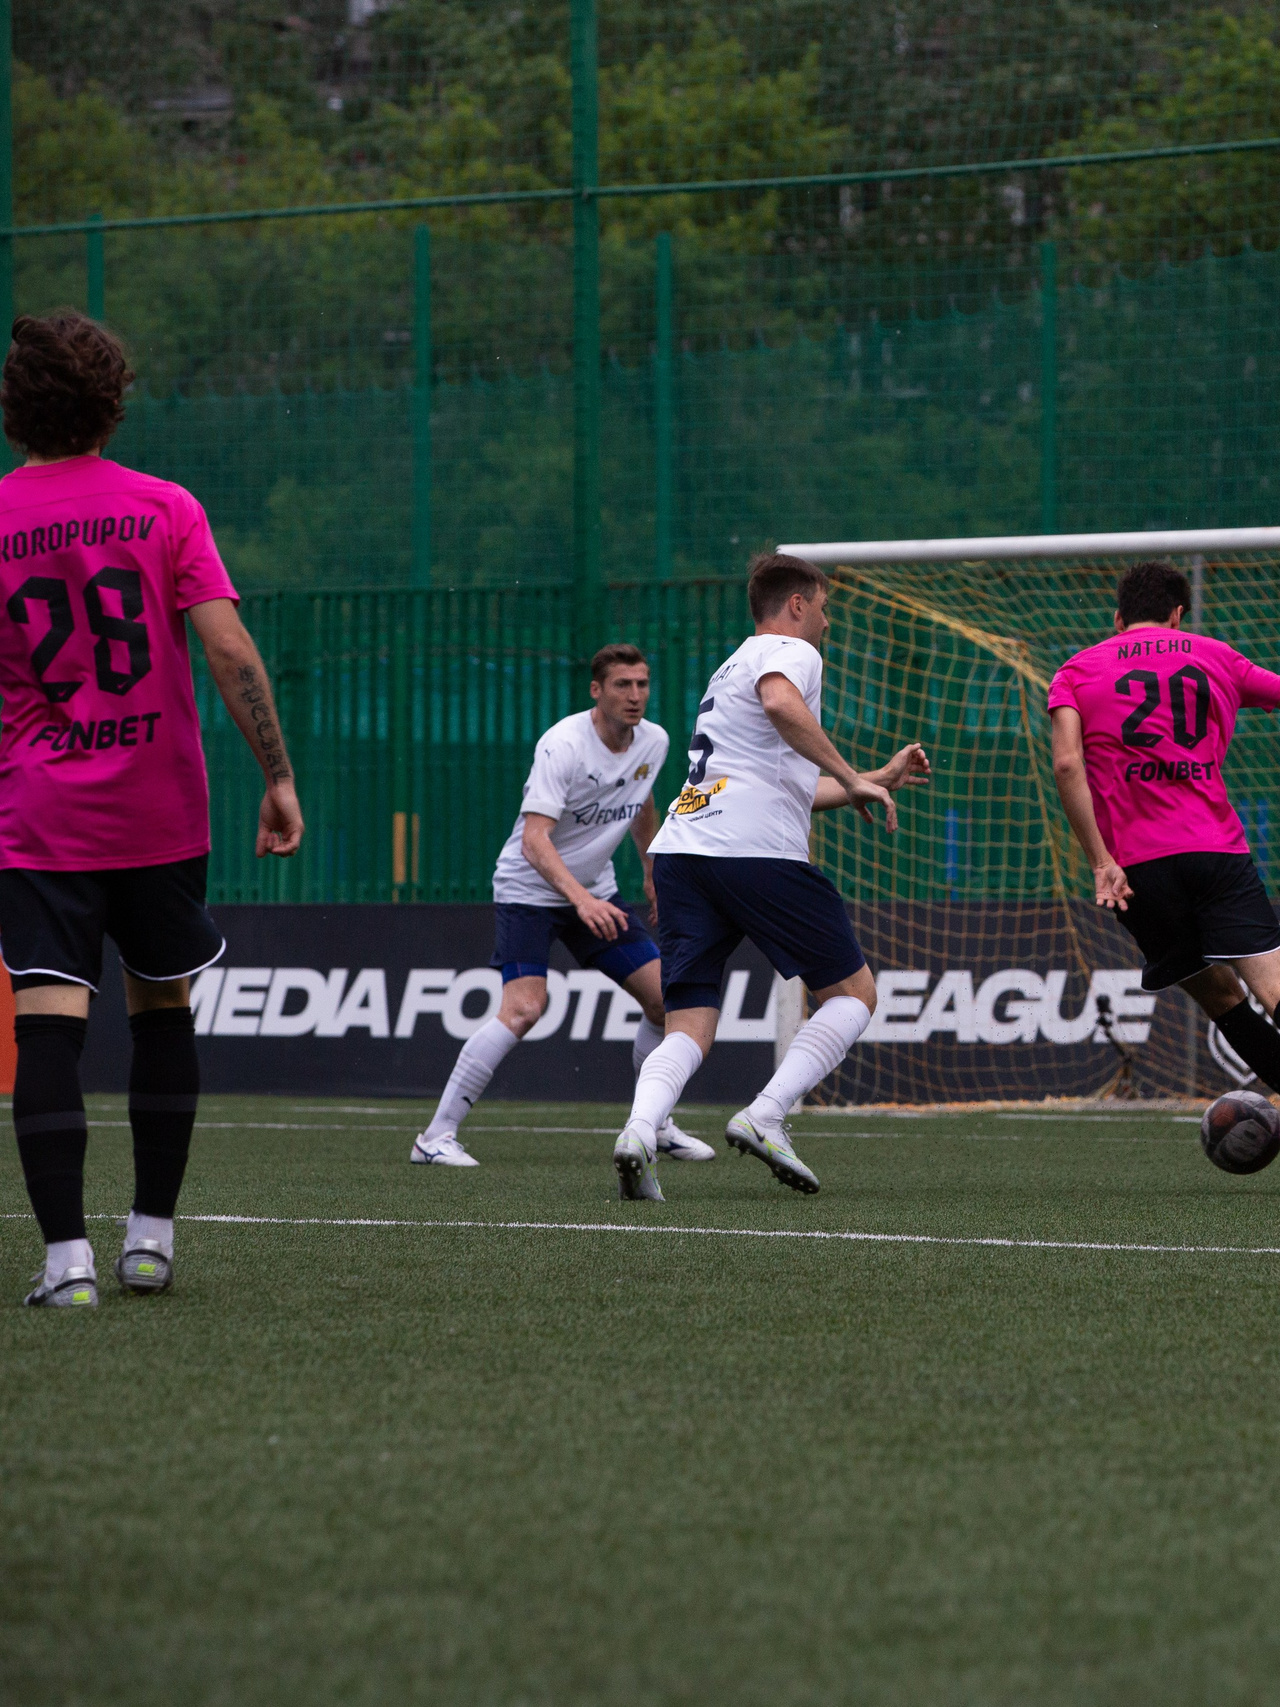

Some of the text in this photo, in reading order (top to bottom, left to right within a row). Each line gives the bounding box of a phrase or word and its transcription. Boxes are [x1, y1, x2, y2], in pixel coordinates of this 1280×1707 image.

[8, 566, 152, 702] 28
[1117, 639, 1192, 660] NATCHO
[28, 712, 161, 752] FONBET
[1114, 664, 1210, 750] 20
[1125, 760, 1215, 783] FONBET
[846, 968, 1157, 1045] EAGUE
